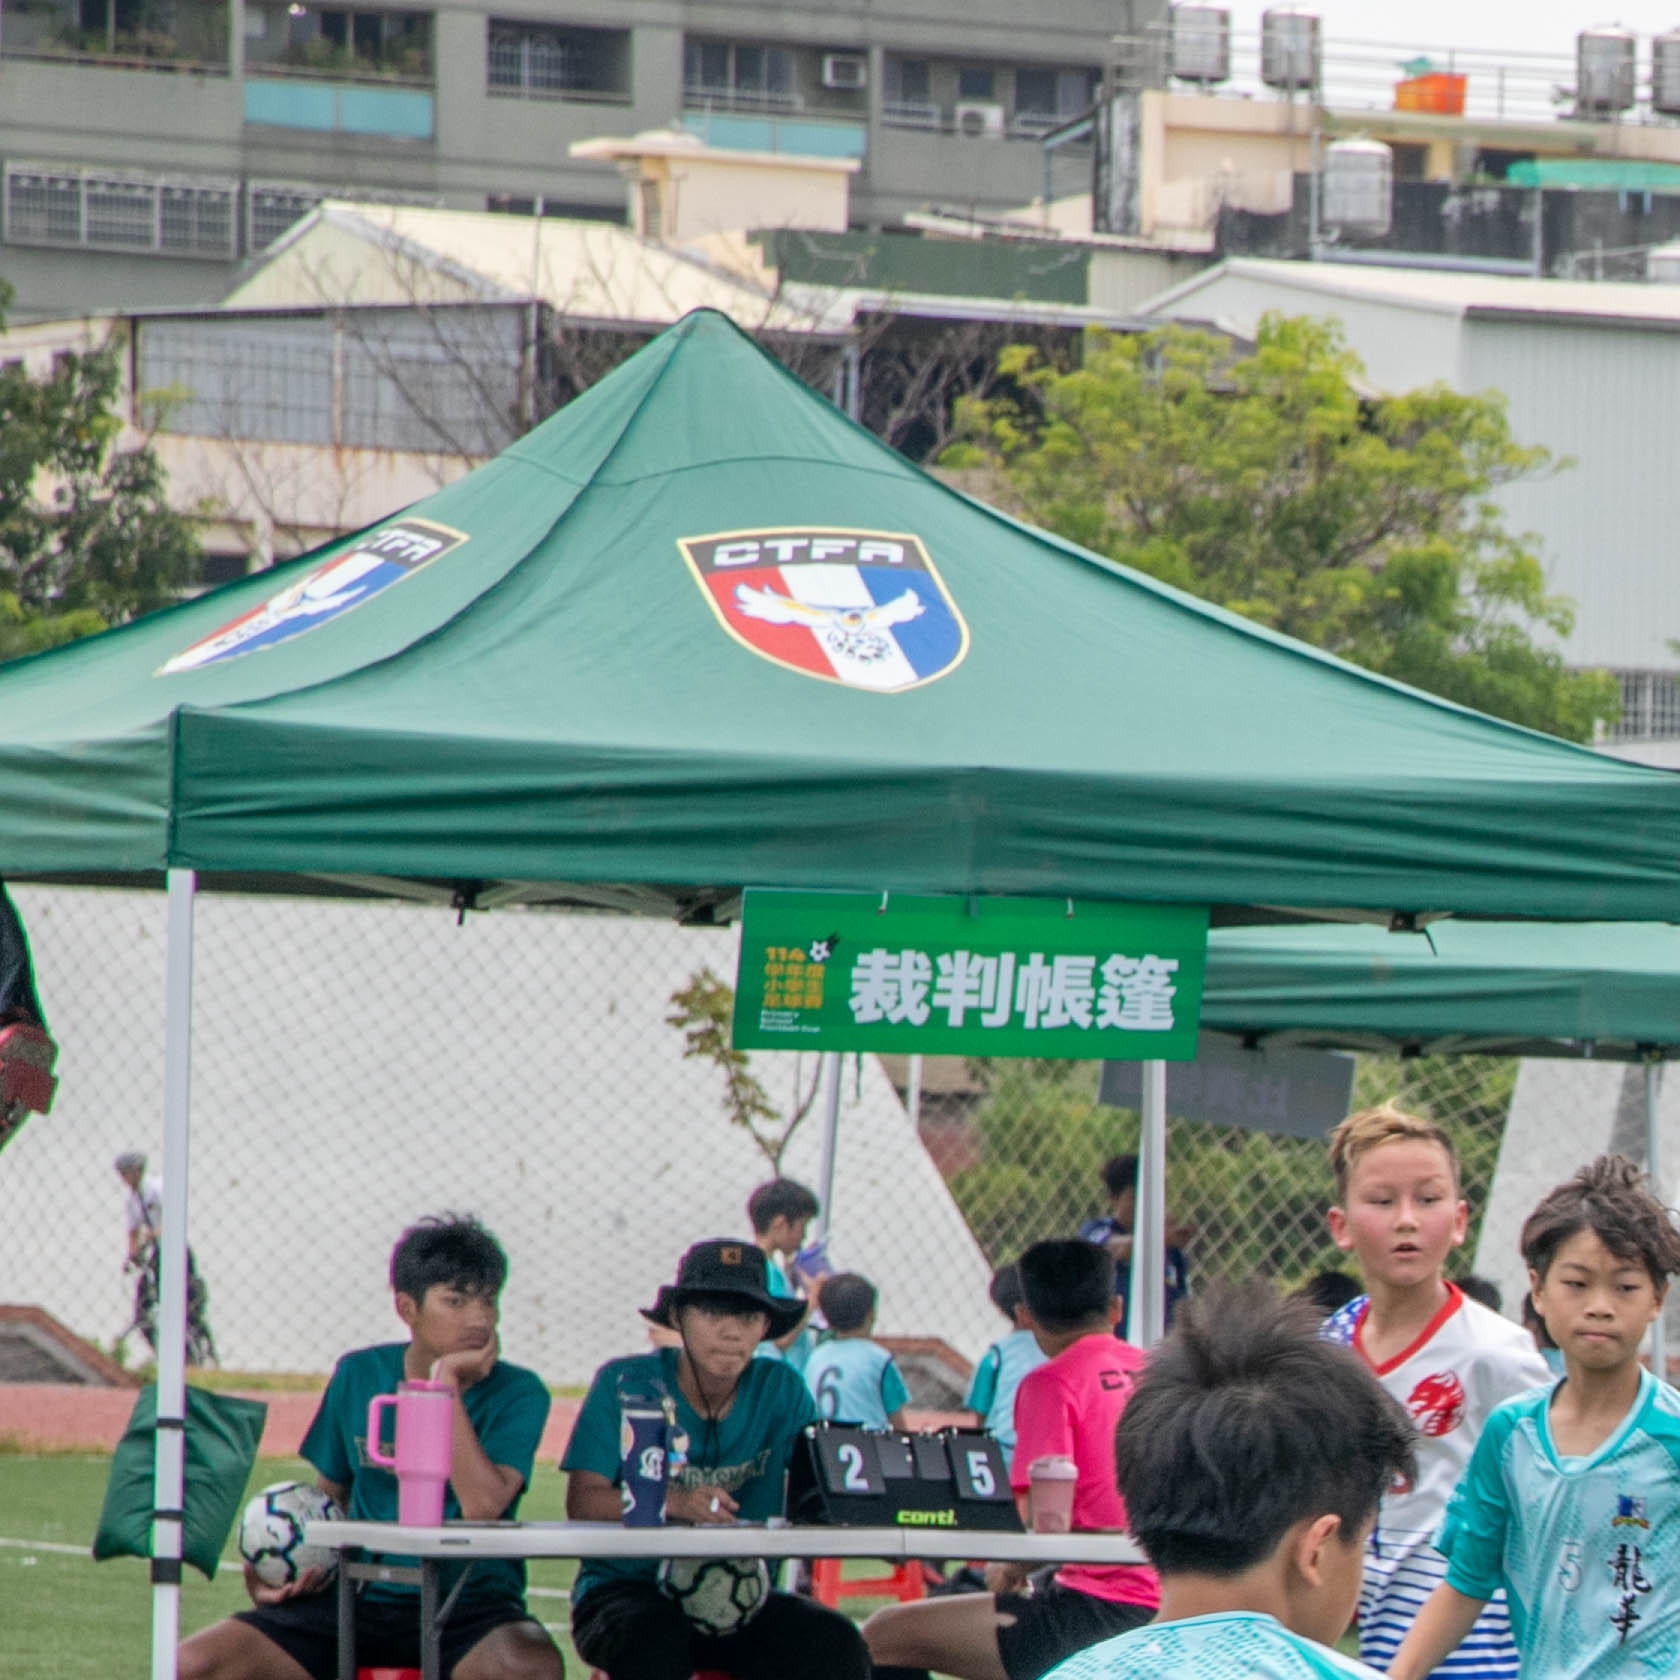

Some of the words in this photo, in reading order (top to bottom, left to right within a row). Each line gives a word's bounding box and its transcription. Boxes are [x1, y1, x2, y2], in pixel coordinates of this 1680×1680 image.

[712, 538, 905, 567] CTFA
[848, 948, 1179, 1031] 裁判帳篷
[817, 1365, 842, 1419] 6
[838, 1444, 869, 1491] 2
[966, 1451, 996, 1497] 5
[1558, 1539, 1582, 1592] 5
